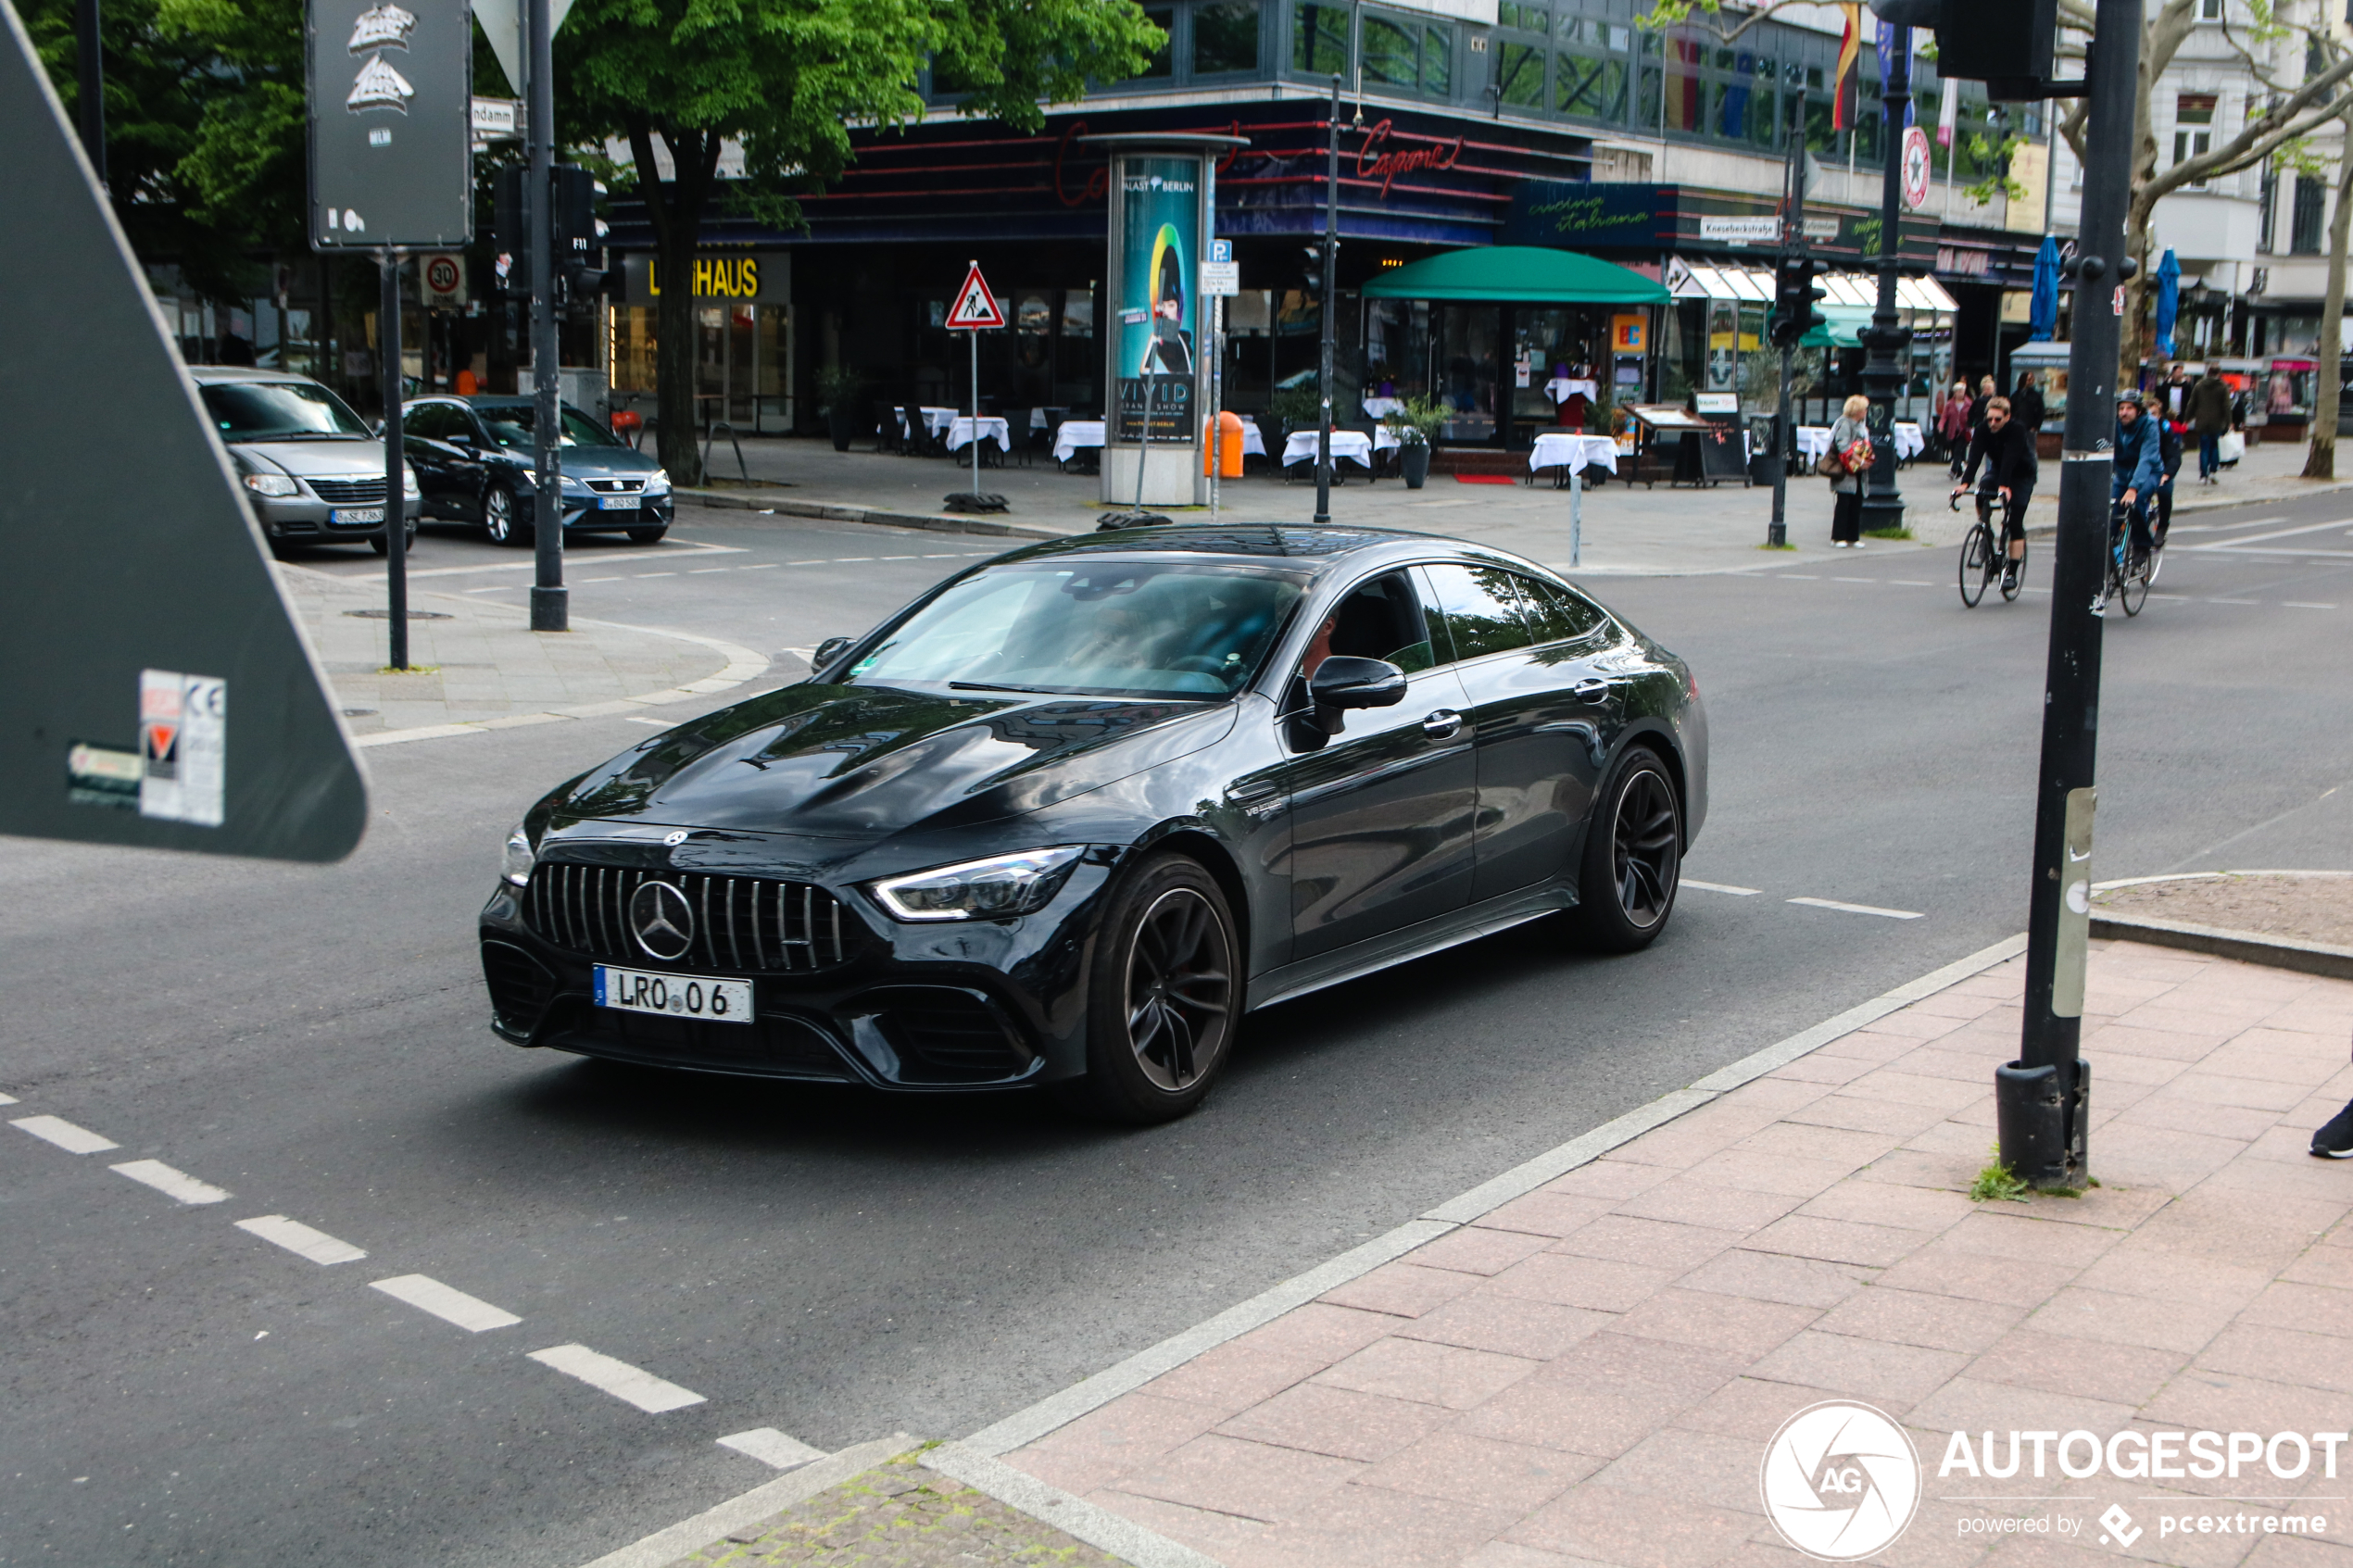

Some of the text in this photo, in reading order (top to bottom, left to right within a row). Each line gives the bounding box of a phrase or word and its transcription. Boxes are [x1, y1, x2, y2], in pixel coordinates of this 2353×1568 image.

[1162, 181, 1194, 194] BERLIN
[1705, 222, 1773, 237] Knesebeckstraße
[1214, 243, 1227, 262] P
[434, 266, 453, 284] 30
[1619, 325, 1640, 345] EC
[1119, 383, 1189, 403] VIVID
[1156, 403, 1185, 411] SHOW
[1245, 806, 1259, 817] V8
[619, 973, 667, 1010] LRO
